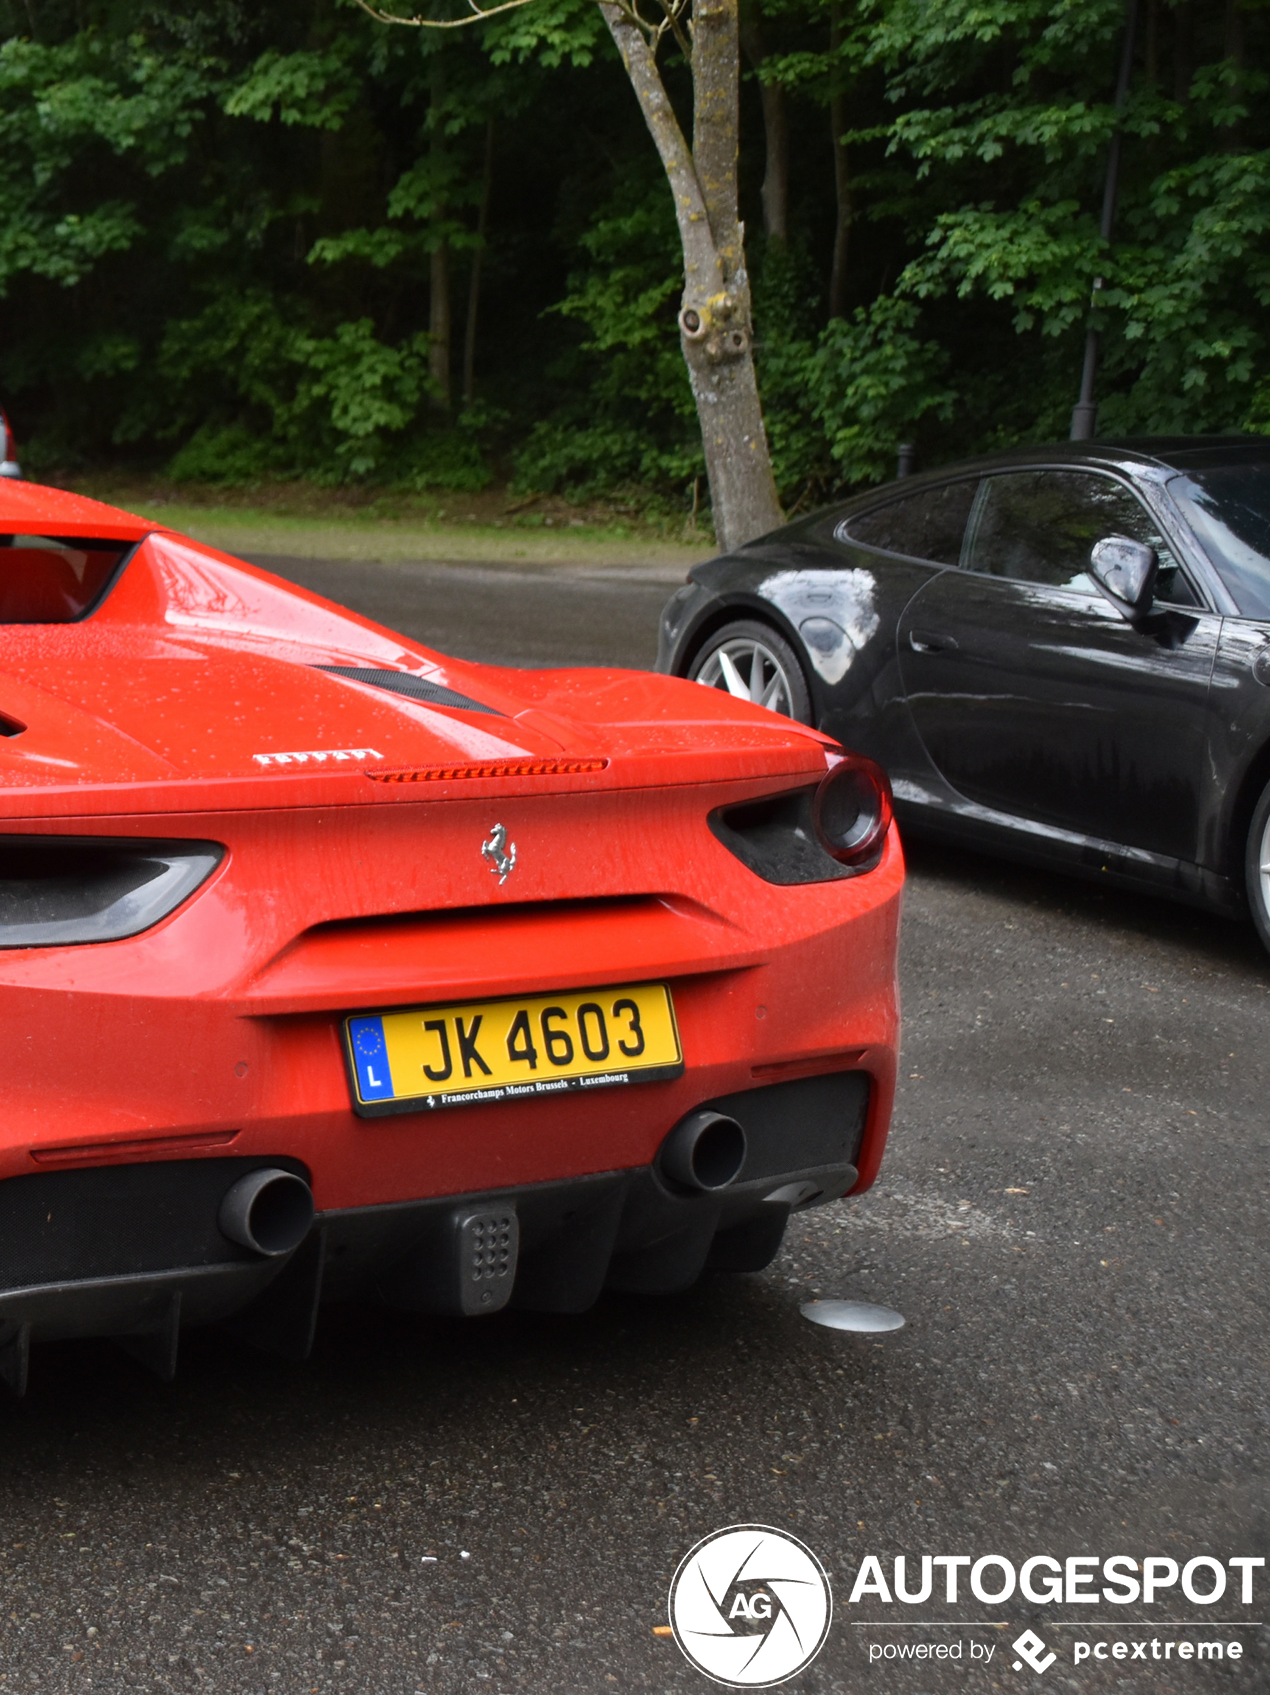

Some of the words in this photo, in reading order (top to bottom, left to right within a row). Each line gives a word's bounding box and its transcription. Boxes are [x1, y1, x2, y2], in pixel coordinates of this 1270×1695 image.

[422, 1015, 493, 1081] JK
[505, 998, 645, 1070] 4603
[368, 1066, 382, 1087] L
[441, 1089, 504, 1103] Francorchamps
[505, 1084, 534, 1095] Motors
[535, 1079, 568, 1091] Brussels
[579, 1073, 628, 1086] Luxembourg
